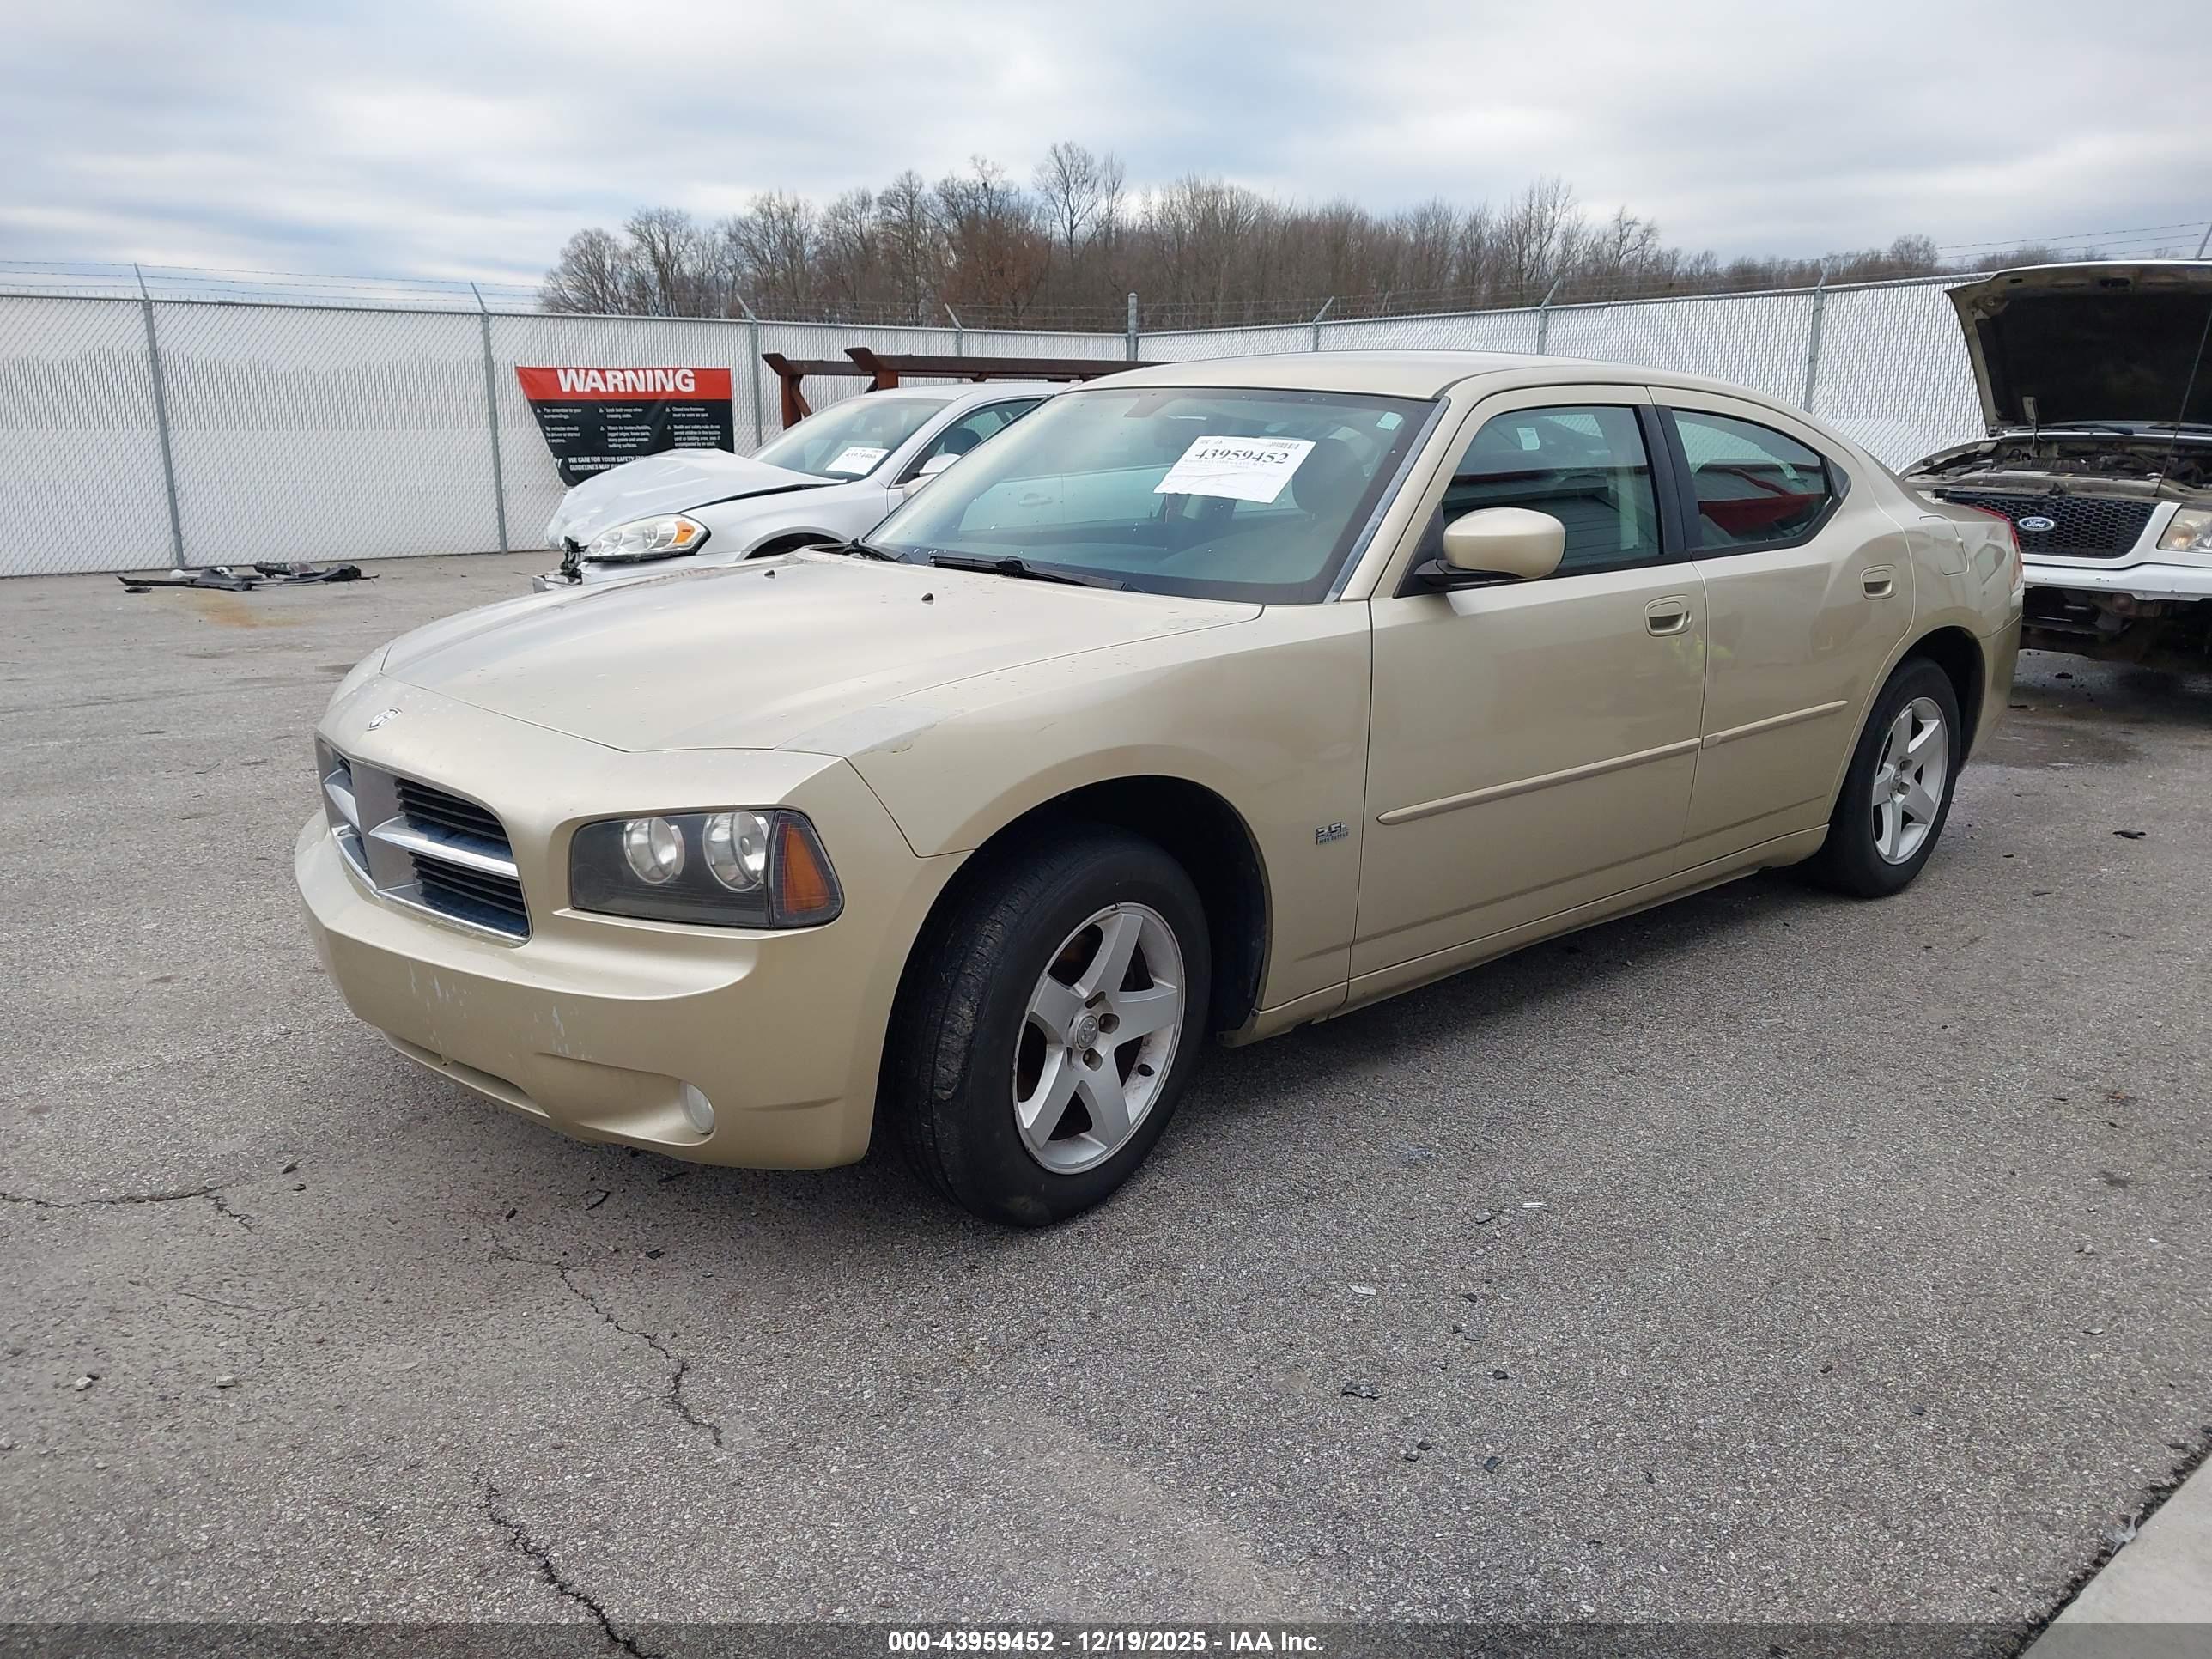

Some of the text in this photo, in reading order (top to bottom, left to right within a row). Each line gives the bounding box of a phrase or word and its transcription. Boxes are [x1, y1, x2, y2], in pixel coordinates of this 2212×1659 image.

[557, 368, 695, 392] WARNING
[1195, 448, 1289, 464] 43959452
[2027, 519, 2046, 528] Ford
